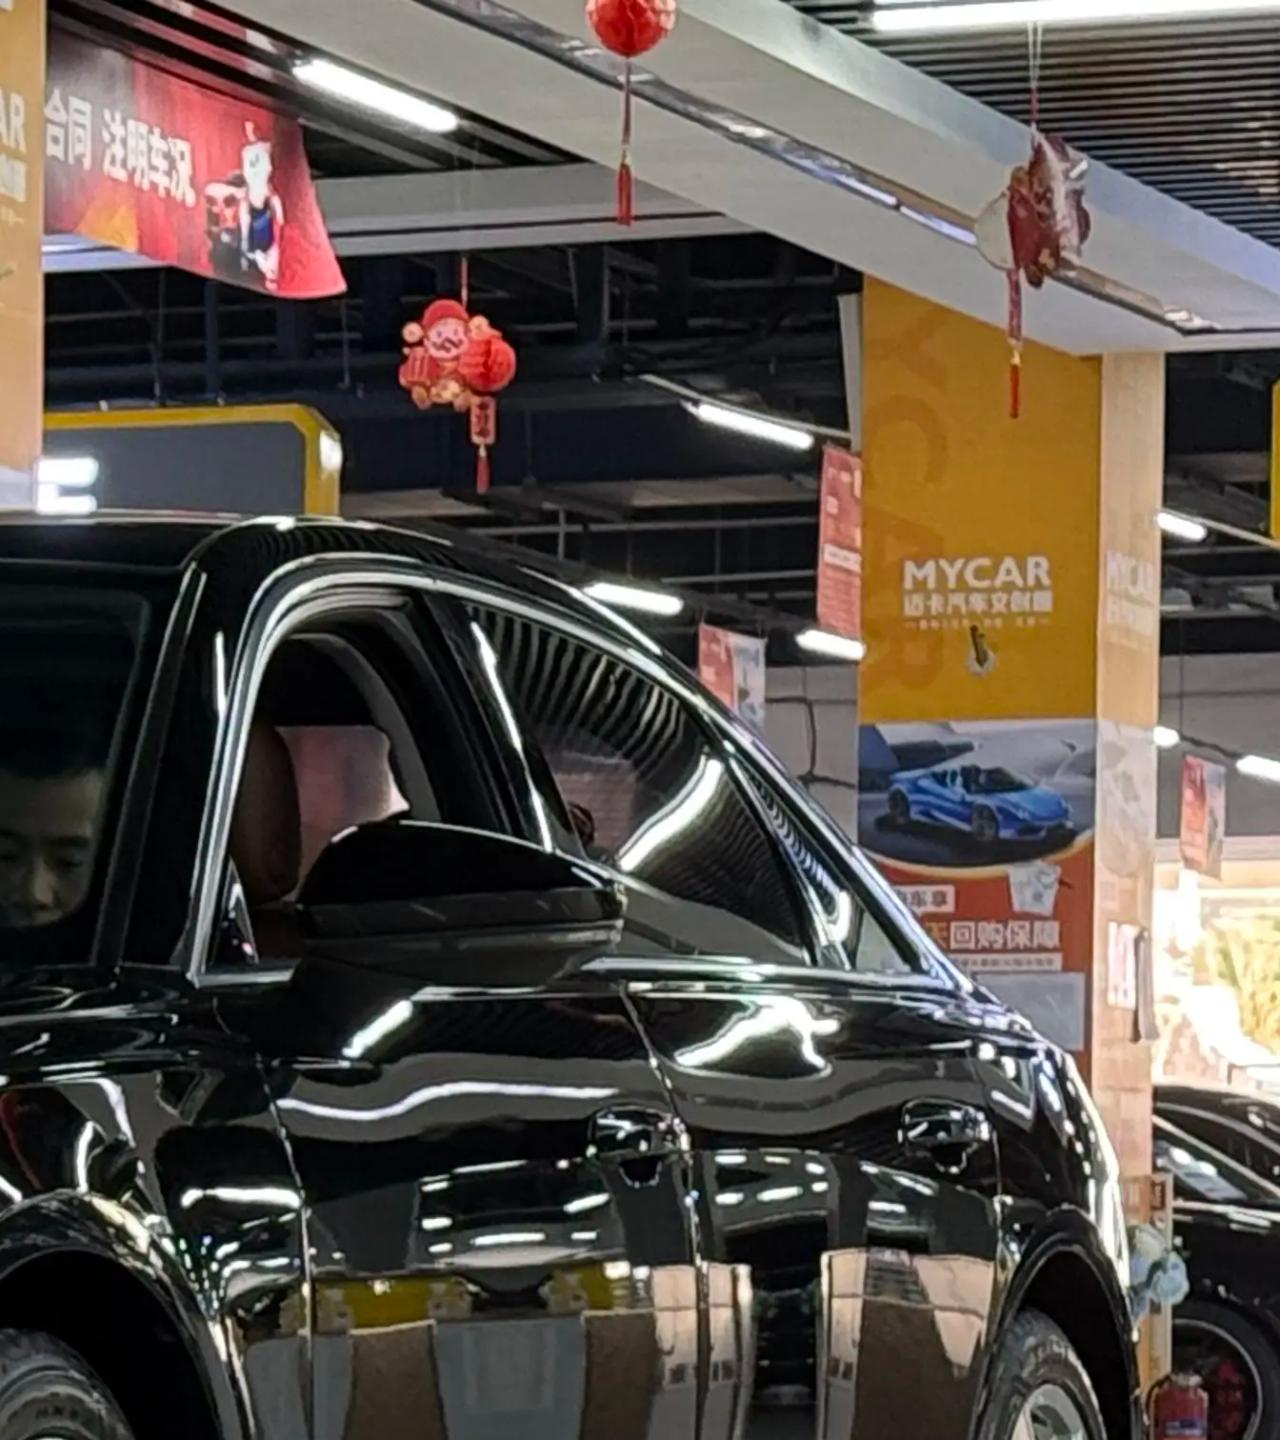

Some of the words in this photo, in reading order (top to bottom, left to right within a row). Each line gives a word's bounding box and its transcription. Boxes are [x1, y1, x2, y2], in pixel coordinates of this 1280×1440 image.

[43, 87, 92, 172] 合同
[101, 107, 197, 208] 注明车况
[902, 555, 1052, 590] MYCAR
